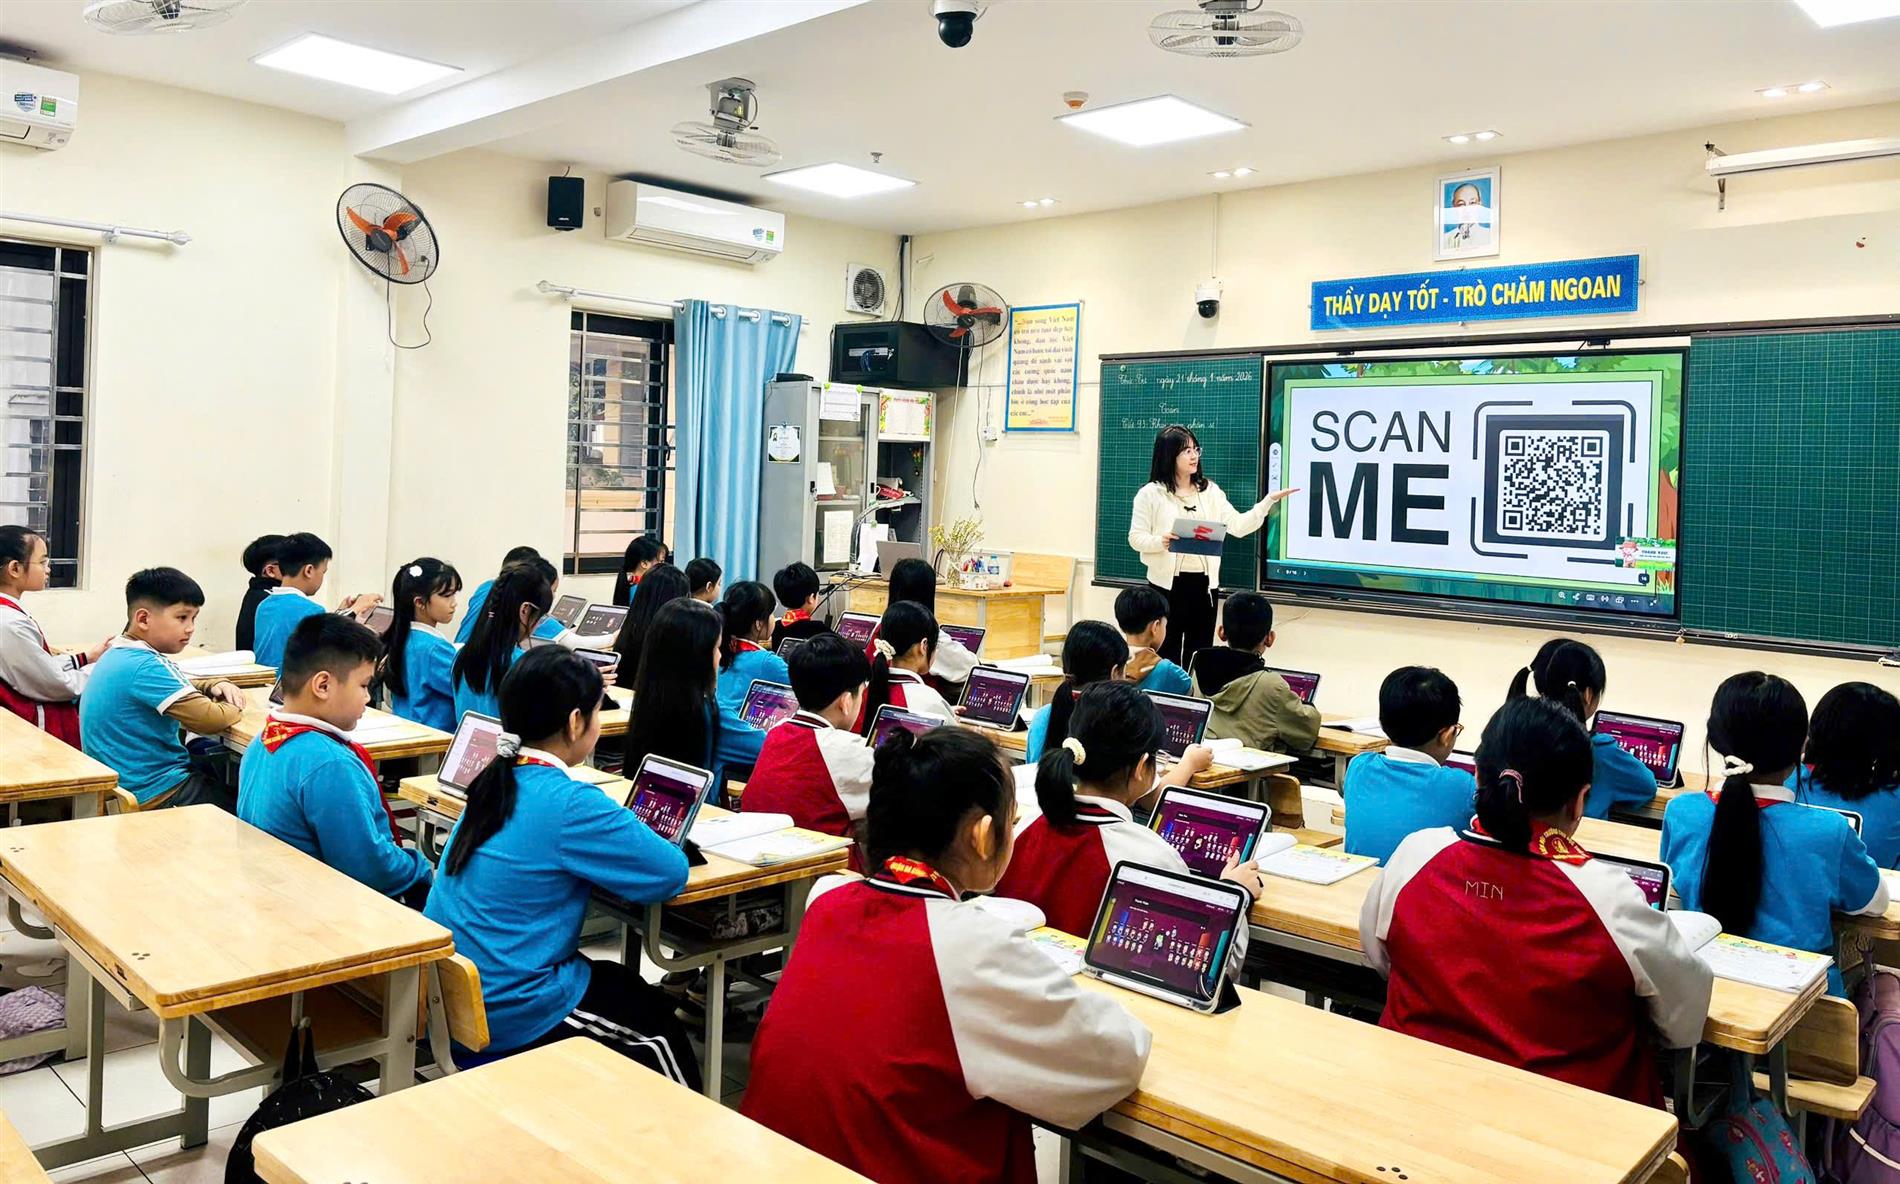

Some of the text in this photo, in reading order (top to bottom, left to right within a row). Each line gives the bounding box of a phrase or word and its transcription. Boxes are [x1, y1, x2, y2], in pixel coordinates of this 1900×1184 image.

[1324, 287, 1363, 316] THẦY
[1369, 292, 1403, 319] DẠY
[1407, 279, 1440, 311] TỐT
[1453, 279, 1487, 308] TRÒ
[1492, 275, 1546, 306] CHĂM
[1550, 274, 1622, 301] NGOAN
[1156, 375, 1175, 389] ngày
[1186, 371, 1207, 389] tháng
[1311, 410, 1451, 453] SCAN
[1308, 461, 1449, 545] ME
[1465, 880, 1504, 900] MIN
